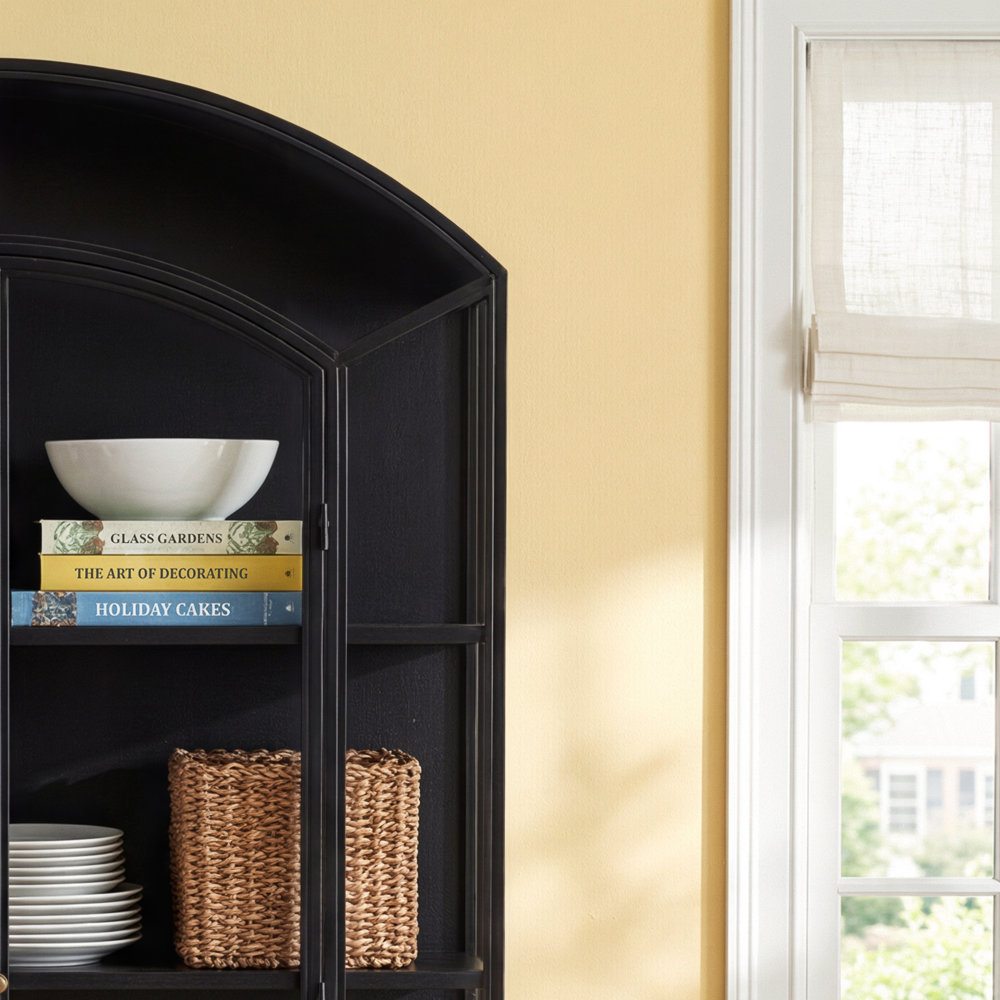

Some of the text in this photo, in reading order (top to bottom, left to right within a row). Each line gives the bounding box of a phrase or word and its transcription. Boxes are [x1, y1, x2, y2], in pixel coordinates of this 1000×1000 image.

[110, 533, 223, 545] GLASS GARDENS
[74, 567, 249, 580] THE ART OF DECORATING
[95, 602, 231, 617] HOLIDAY CAKES
